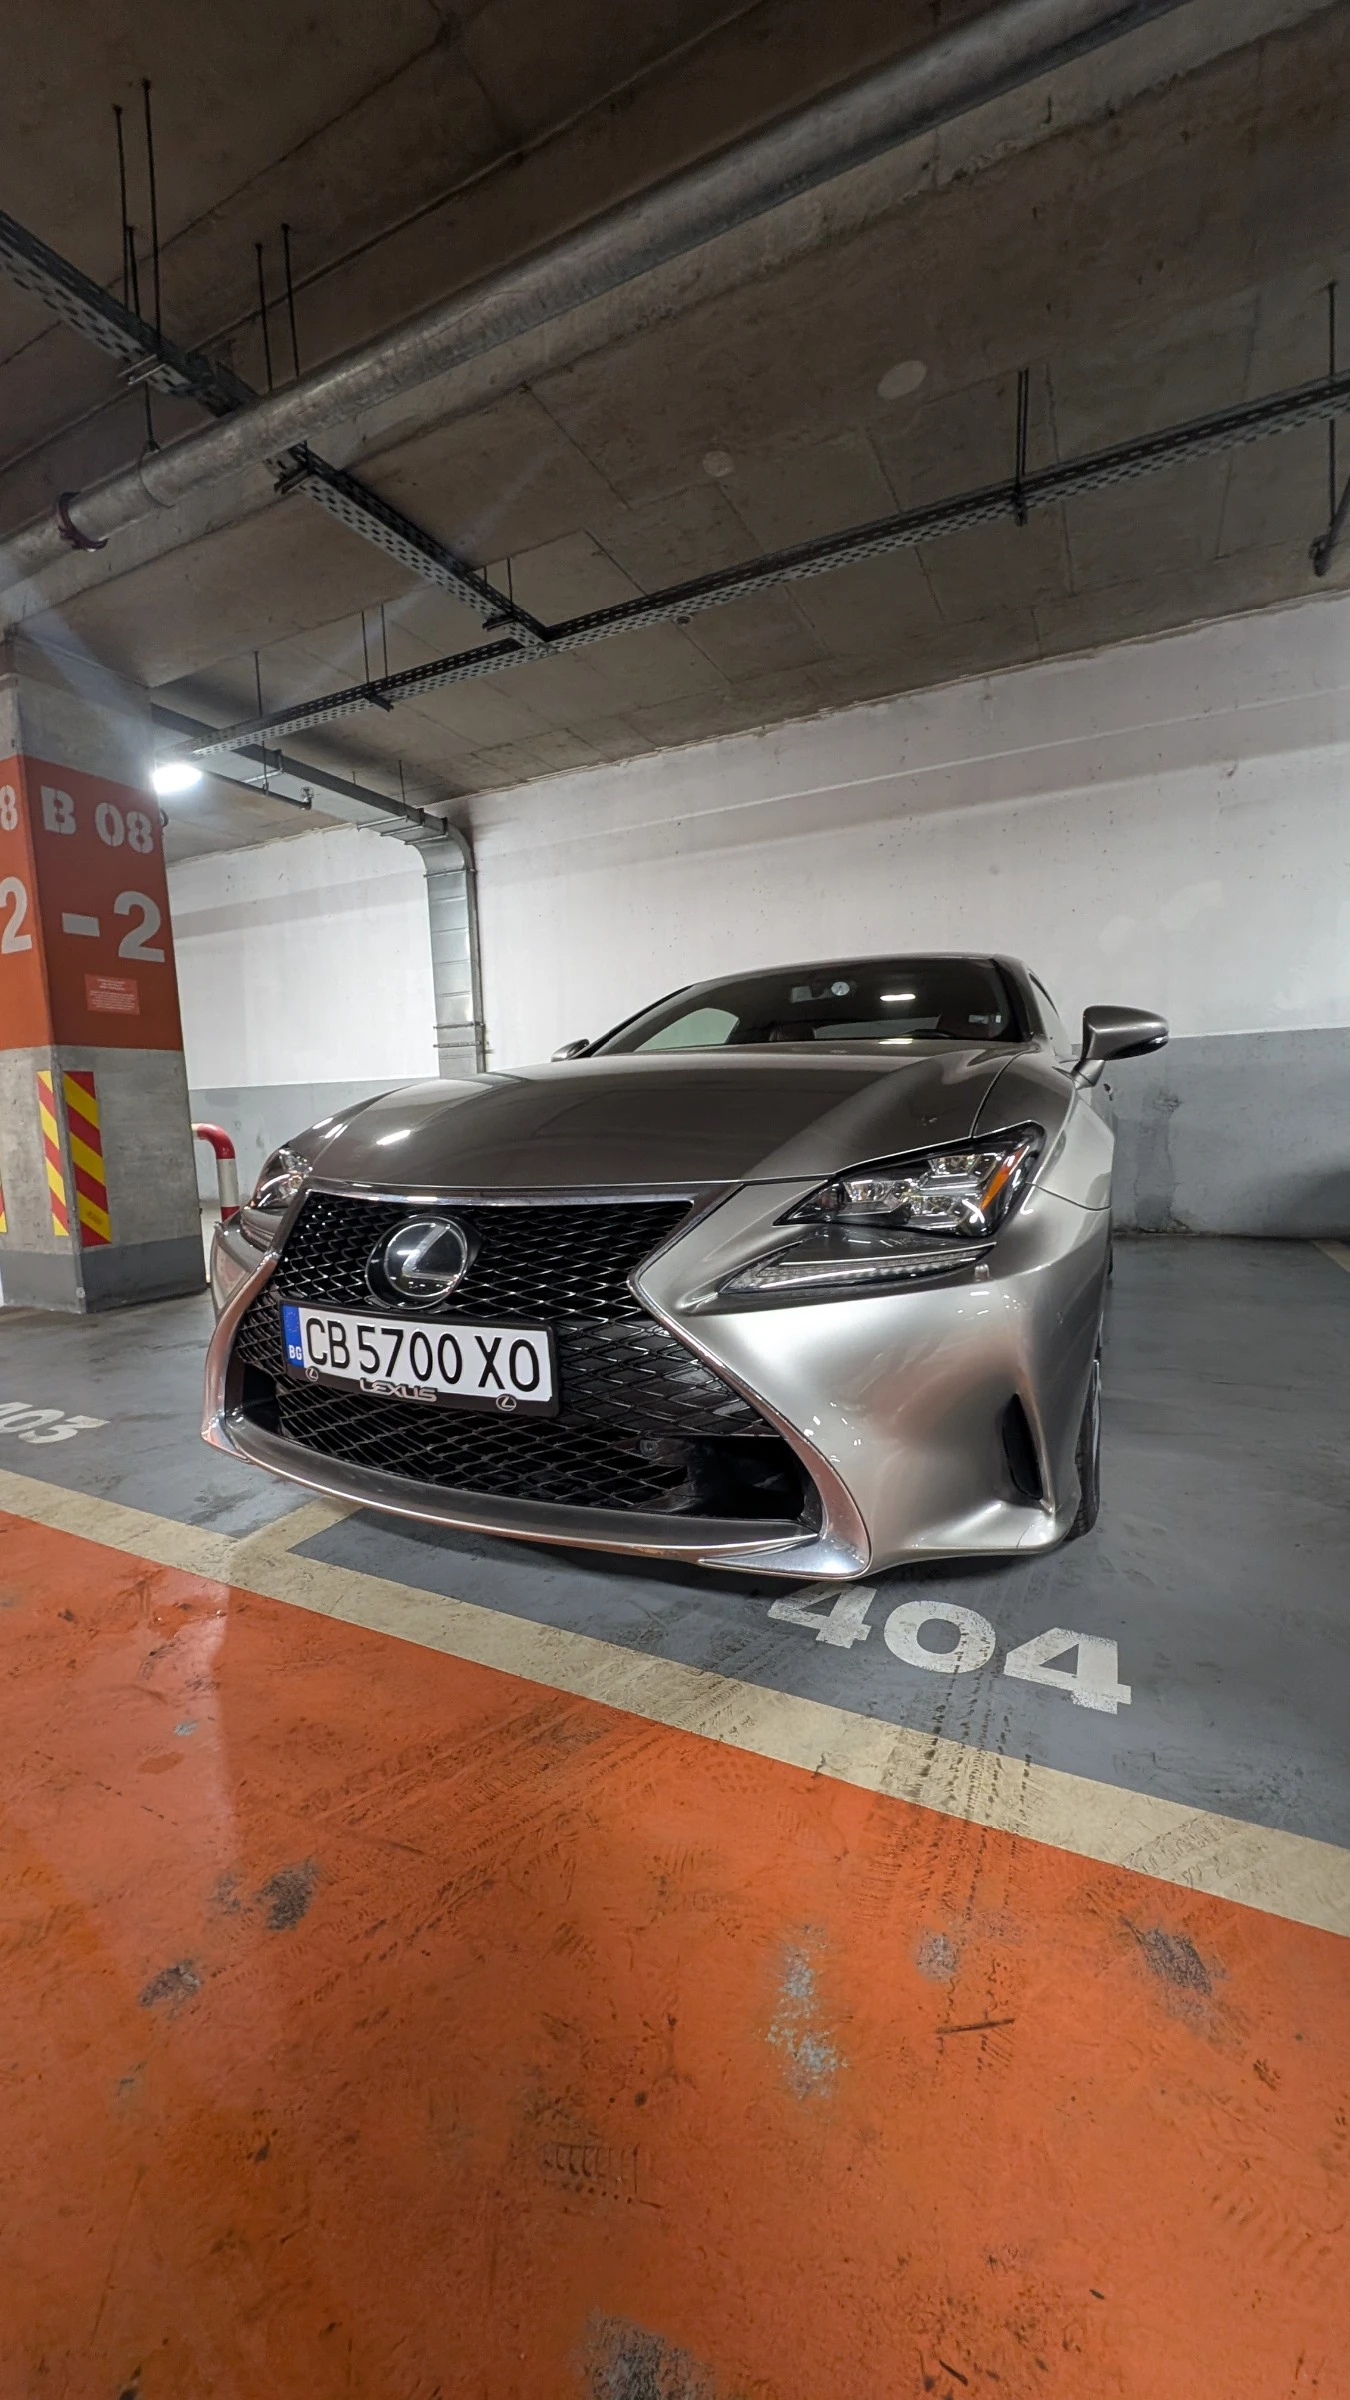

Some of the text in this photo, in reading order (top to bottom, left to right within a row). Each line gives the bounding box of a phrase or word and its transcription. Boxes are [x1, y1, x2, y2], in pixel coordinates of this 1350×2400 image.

[41, 785, 154, 854] B 08
[288, 1343, 303, 1361] BG
[474, 1335, 540, 1393] XO
[360, 1378, 438, 1402] LEXUS
[767, 1582, 1132, 1715] 404
